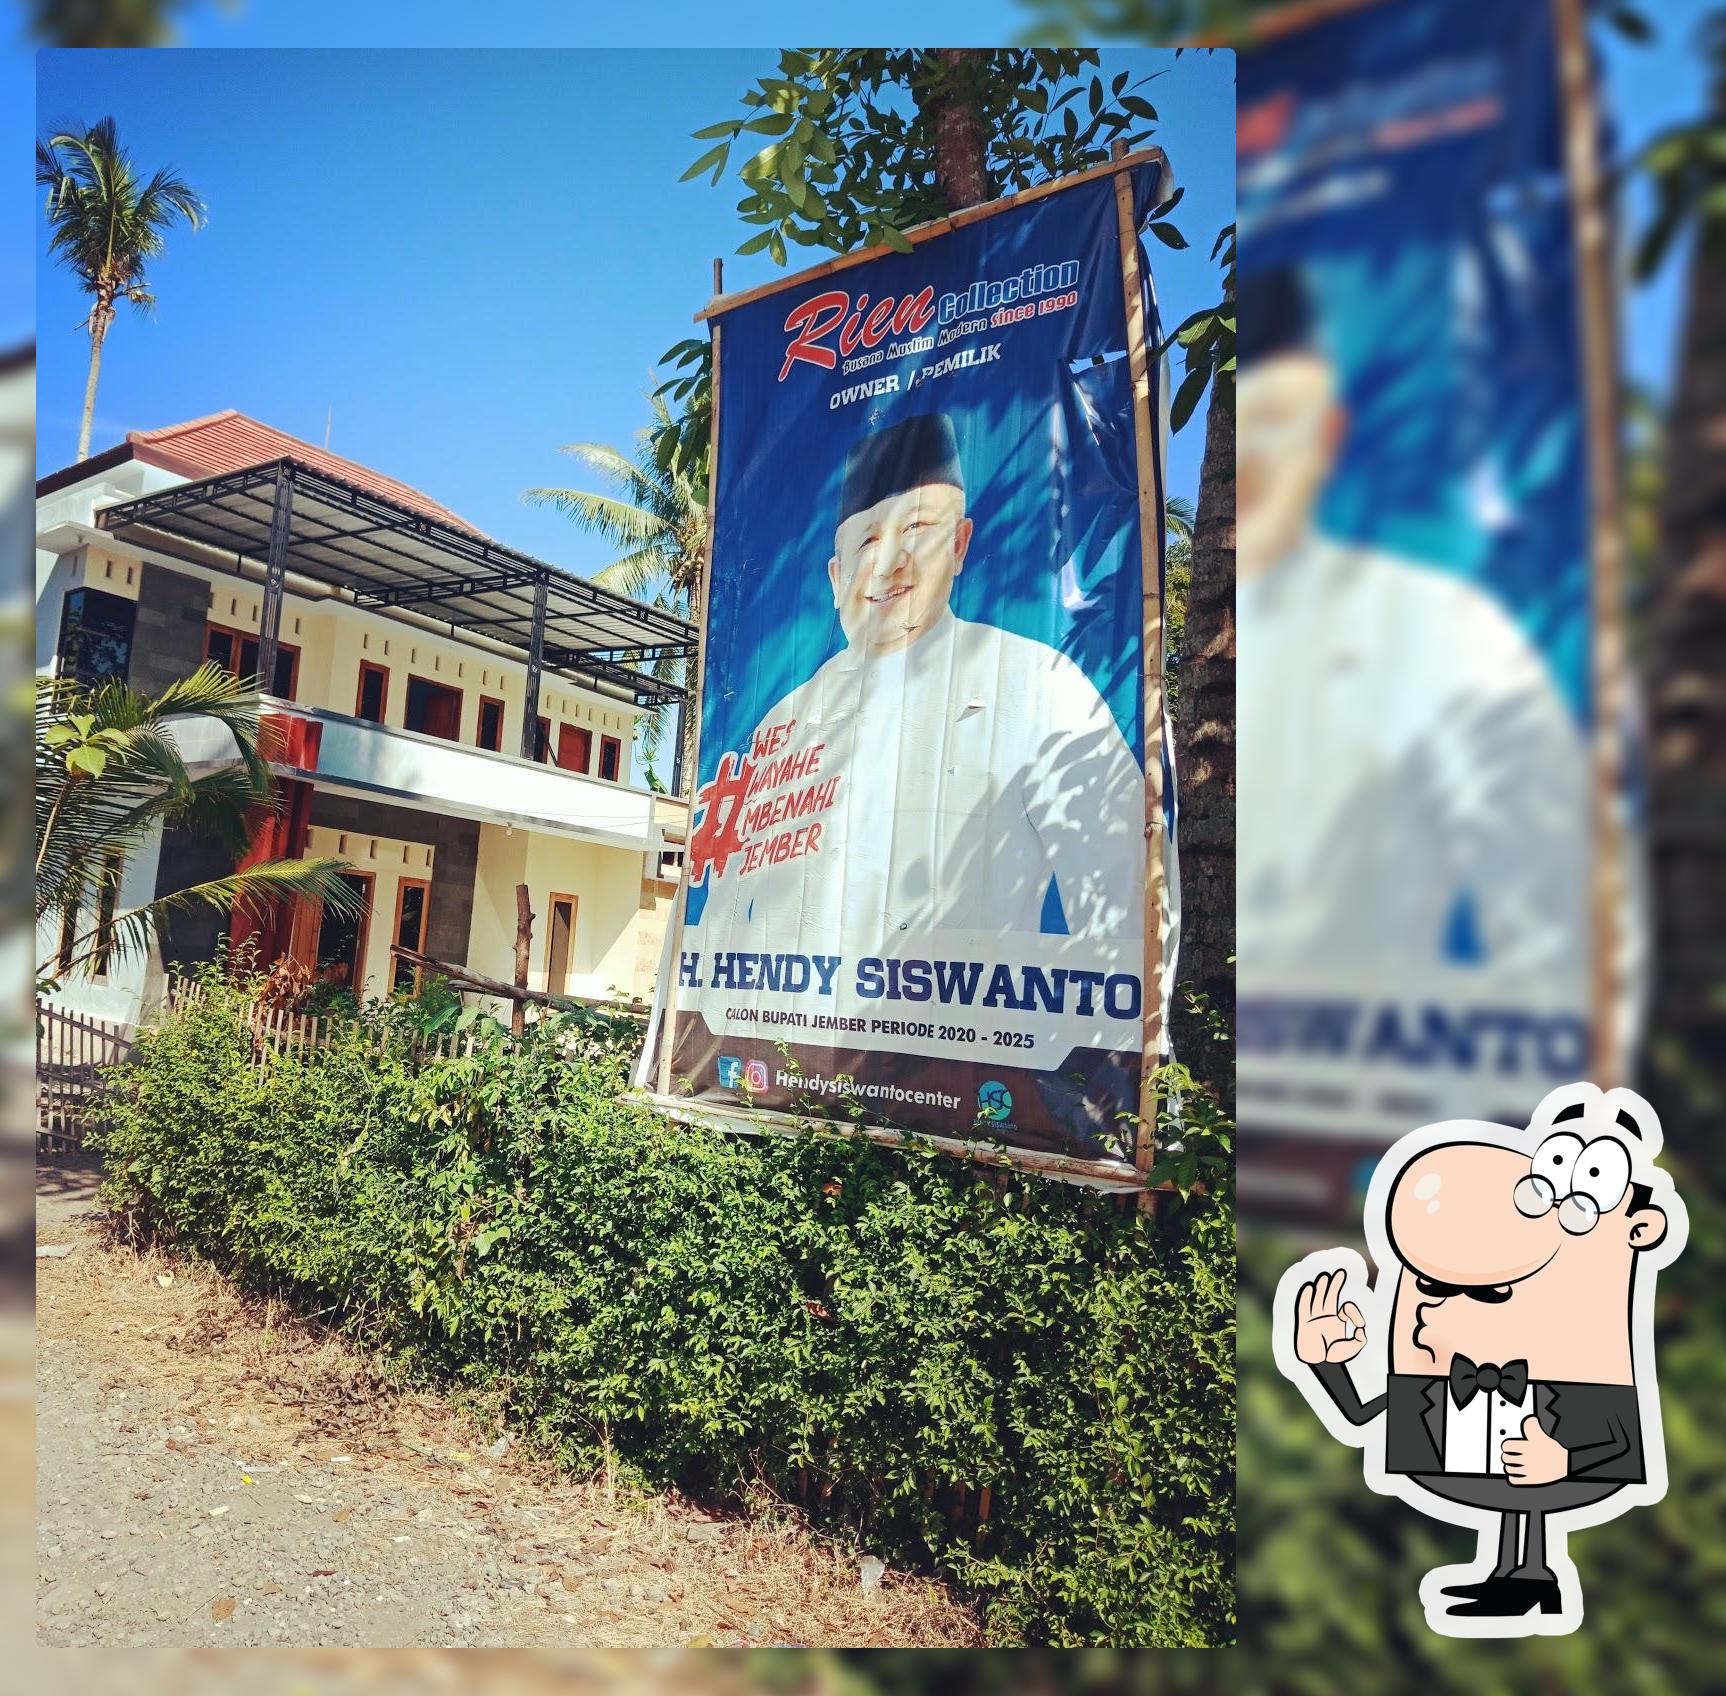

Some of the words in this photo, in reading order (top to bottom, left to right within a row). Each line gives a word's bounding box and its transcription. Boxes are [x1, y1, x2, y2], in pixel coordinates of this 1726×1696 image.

[778, 285, 935, 381] Rien
[937, 260, 1079, 325] Collection
[842, 350, 884, 375] Busana
[887, 335, 934, 360] Muslim
[937, 319, 987, 346] Modern
[990, 304, 1034, 328] since
[1038, 291, 1078, 317] 1990
[829, 373, 900, 410] OWNER
[921, 343, 1001, 379] PEMILIK
[753, 719, 797, 760] WES
[747, 743, 826, 798] WAYAHE
[741, 775, 842, 836] MBENAHI
[739, 822, 822, 876] JEMBER
[678, 951, 703, 988] H.
[710, 952, 842, 996] HENDY
[856, 956, 1142, 1020] SISWANTO
[725, 1007, 759, 1023] CALON
[762, 1010, 808, 1027] BUPATI
[811, 1014, 867, 1033] JEMBER
[871, 1019, 935, 1039] PERIODE
[938, 1025, 976, 1043] 2020
[993, 1030, 1035, 1049] 2025
[775, 1069, 961, 1110] Hendysiswantocenter
